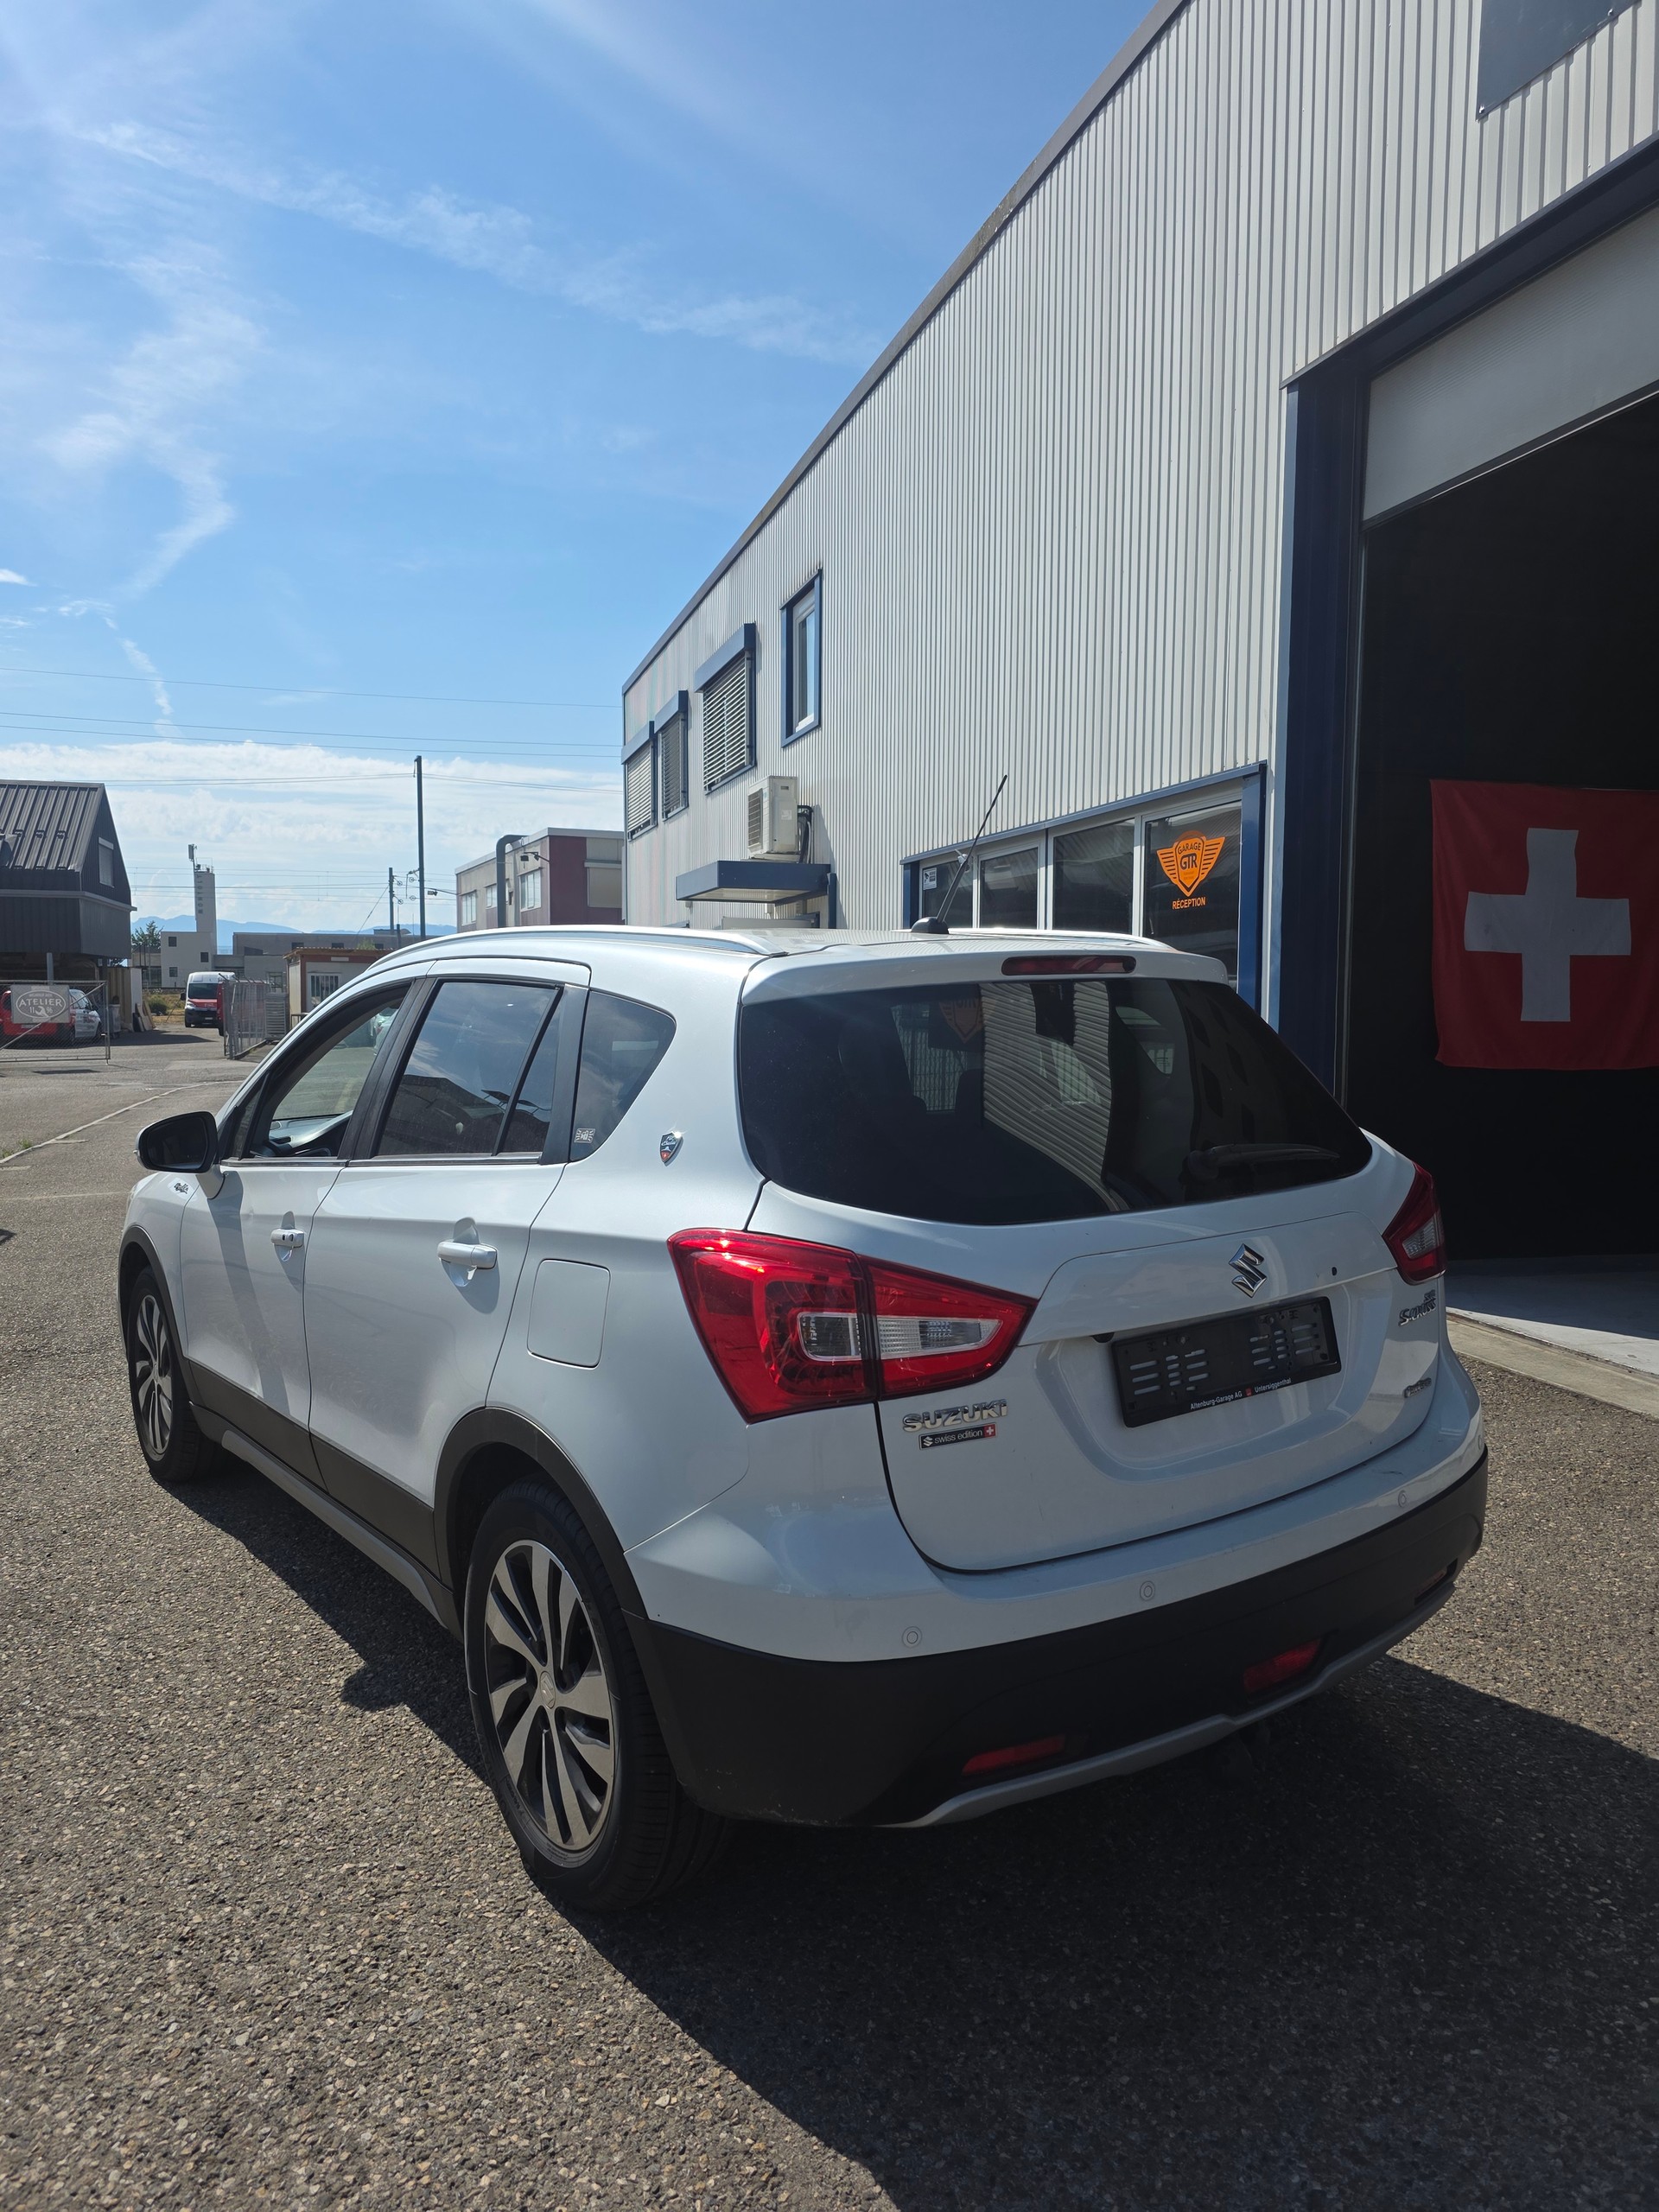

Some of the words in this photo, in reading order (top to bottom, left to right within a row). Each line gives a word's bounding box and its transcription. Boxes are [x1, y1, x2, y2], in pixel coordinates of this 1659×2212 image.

[1178, 842, 1201, 855] GARAGE
[1180, 853, 1198, 870] GTR
[1173, 897, 1206, 910] RÉCEPTION
[19, 998, 62, 1007] ATELIER
[903, 1399, 1008, 1433] SUZUKI
[934, 1433, 957, 1445] swiss
[957, 1428, 983, 1440] edition
